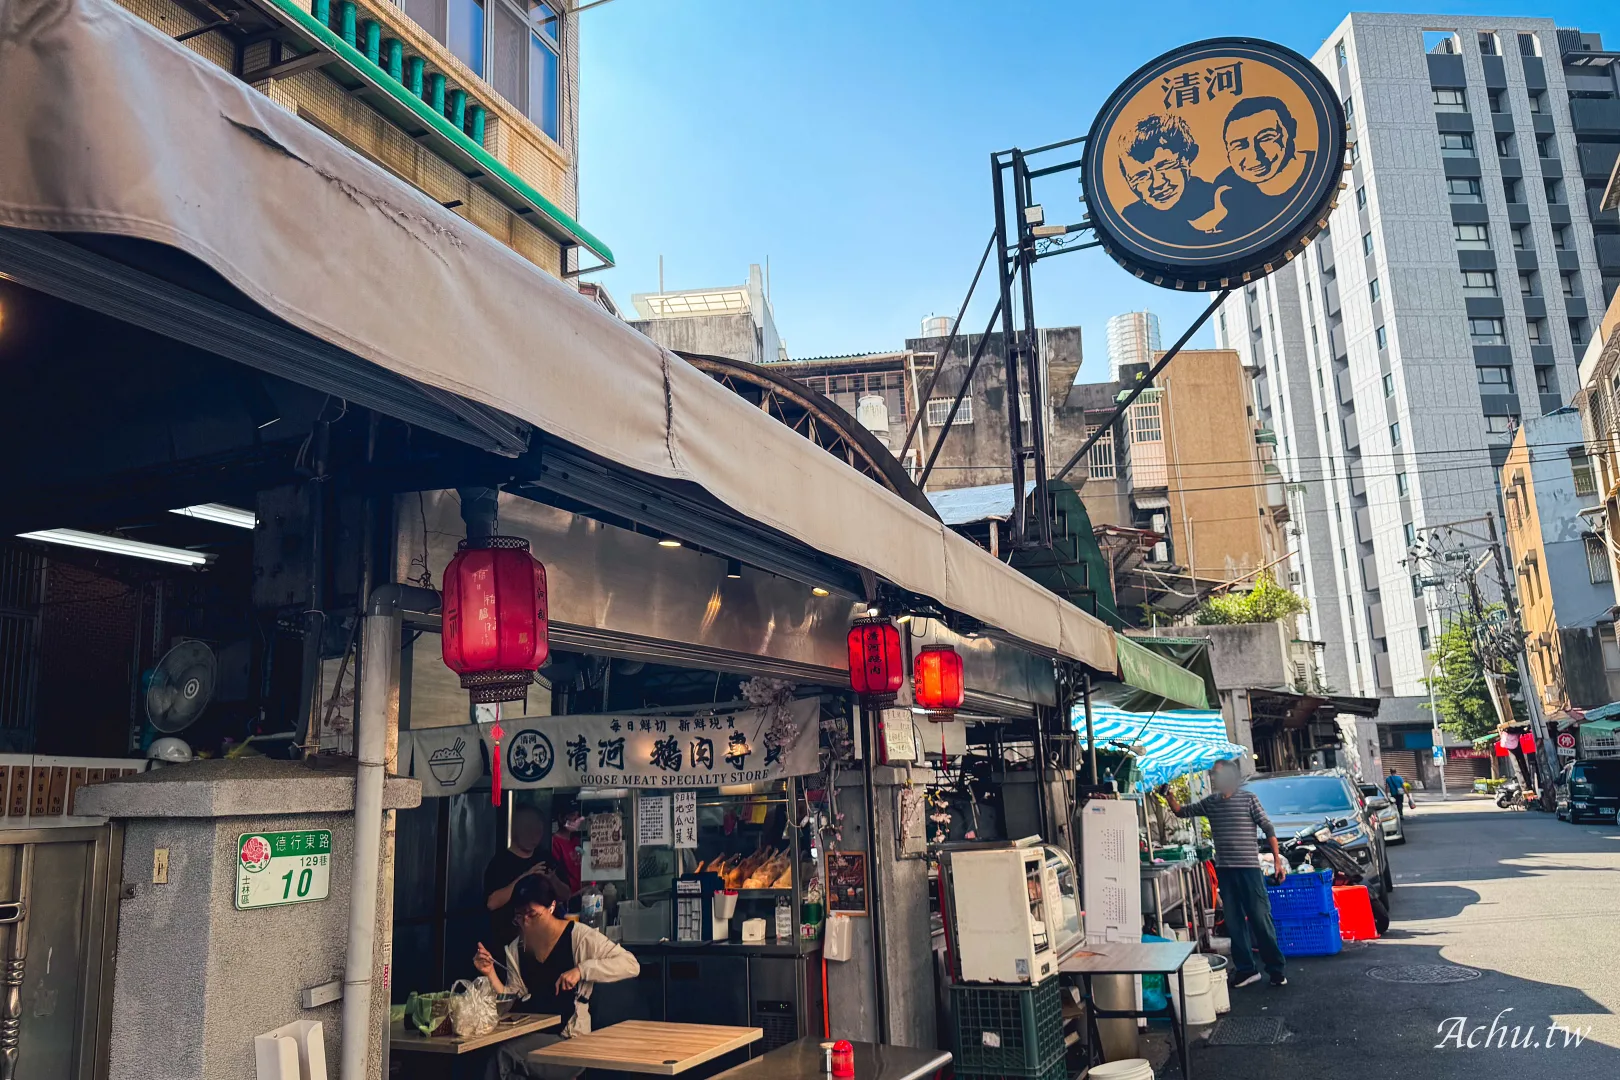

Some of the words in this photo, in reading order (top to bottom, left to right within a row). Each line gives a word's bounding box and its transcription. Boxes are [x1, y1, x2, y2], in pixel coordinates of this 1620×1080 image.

[1161, 61, 1243, 109] 清河
[610, 719, 667, 733] 每日鮮切
[520, 734, 537, 744] 清河
[1561, 736, 1572, 746] 停
[566, 734, 626, 772] 清河
[580, 774, 618, 785] GOOSE
[622, 775, 657, 785] MEAT
[661, 773, 728, 786] SPECIALTY
[730, 769, 769, 783] STORE
[275, 833, 329, 851] 德行東路
[300, 855, 328, 867] 129巷
[241, 875, 251, 905] 士林區
[282, 868, 313, 900] 10
